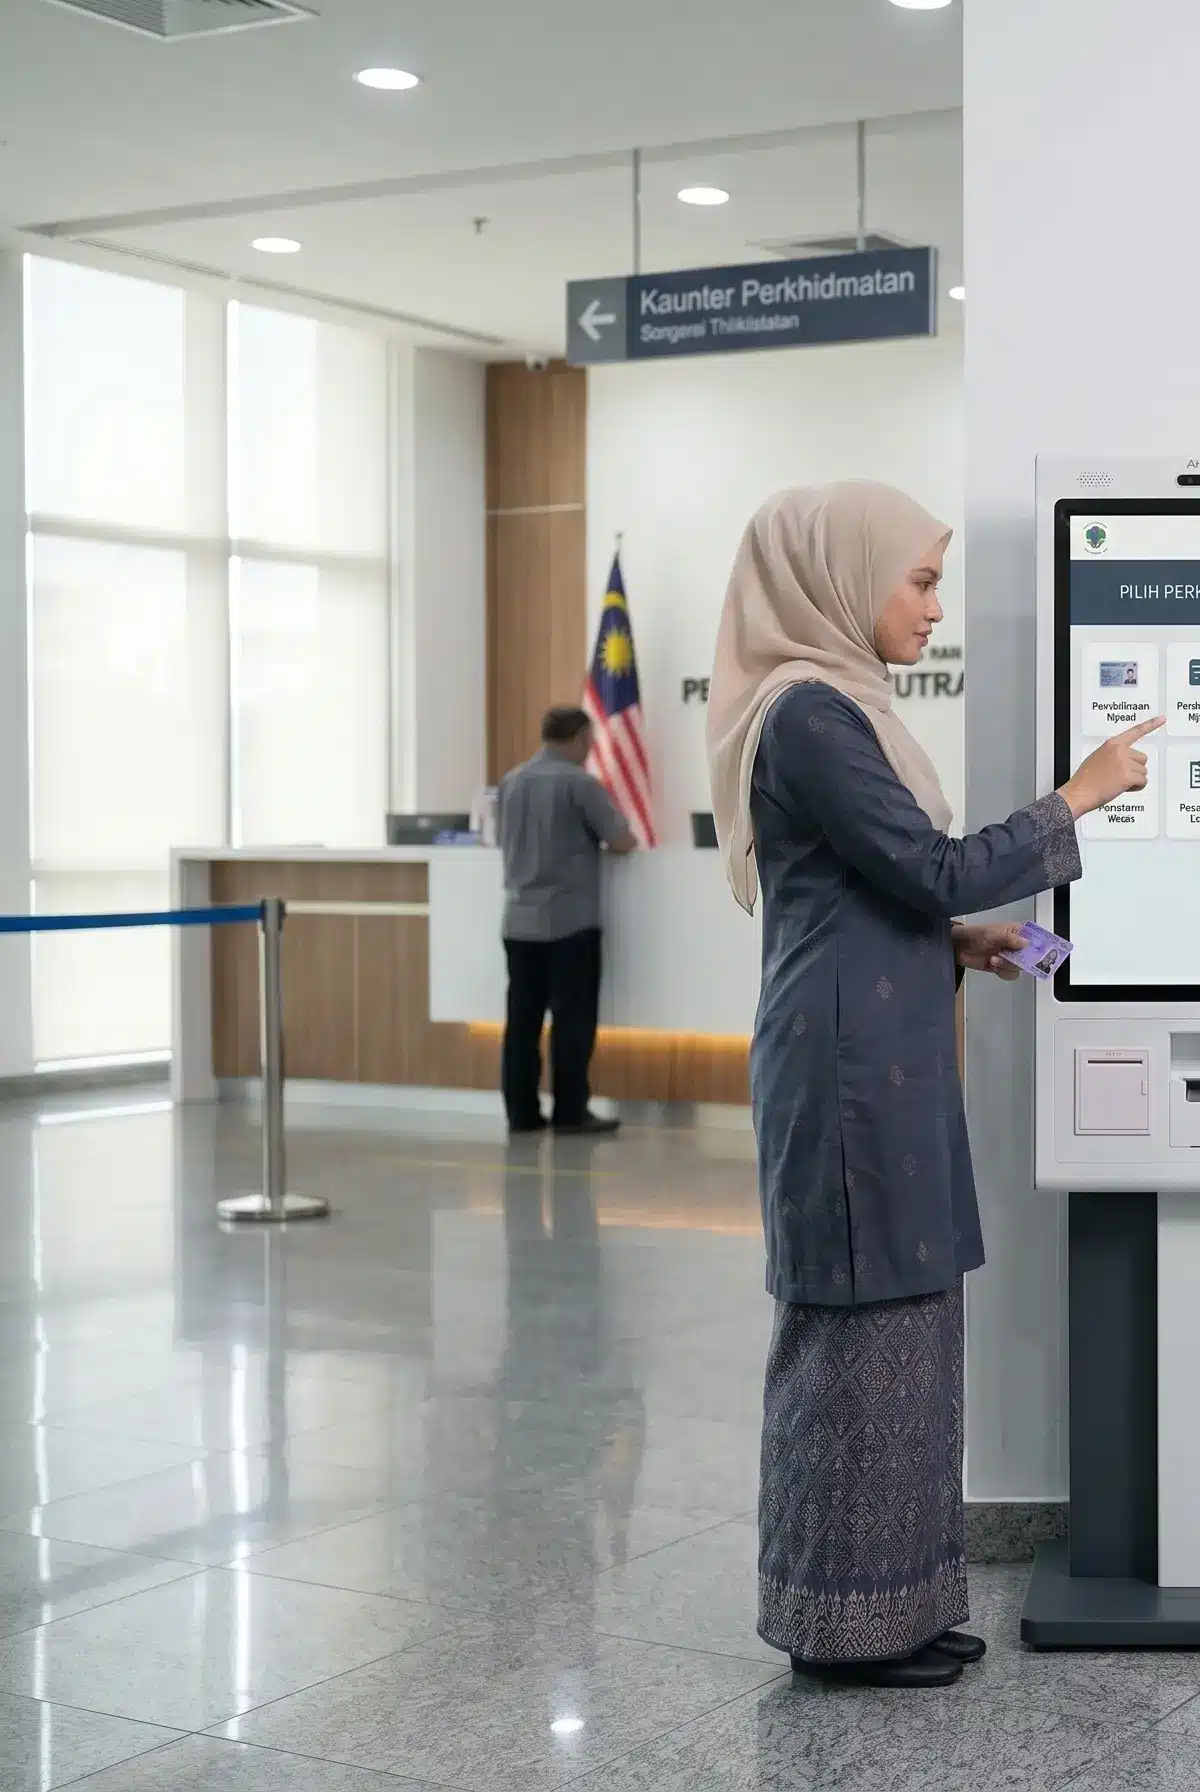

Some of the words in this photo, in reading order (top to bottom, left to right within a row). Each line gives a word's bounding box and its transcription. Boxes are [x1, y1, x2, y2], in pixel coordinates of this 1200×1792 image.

[640, 285, 735, 316] Kaunter
[742, 268, 916, 307] Perkhidmatan
[1119, 584, 1160, 599] PILIH
[894, 671, 965, 698] UTR
